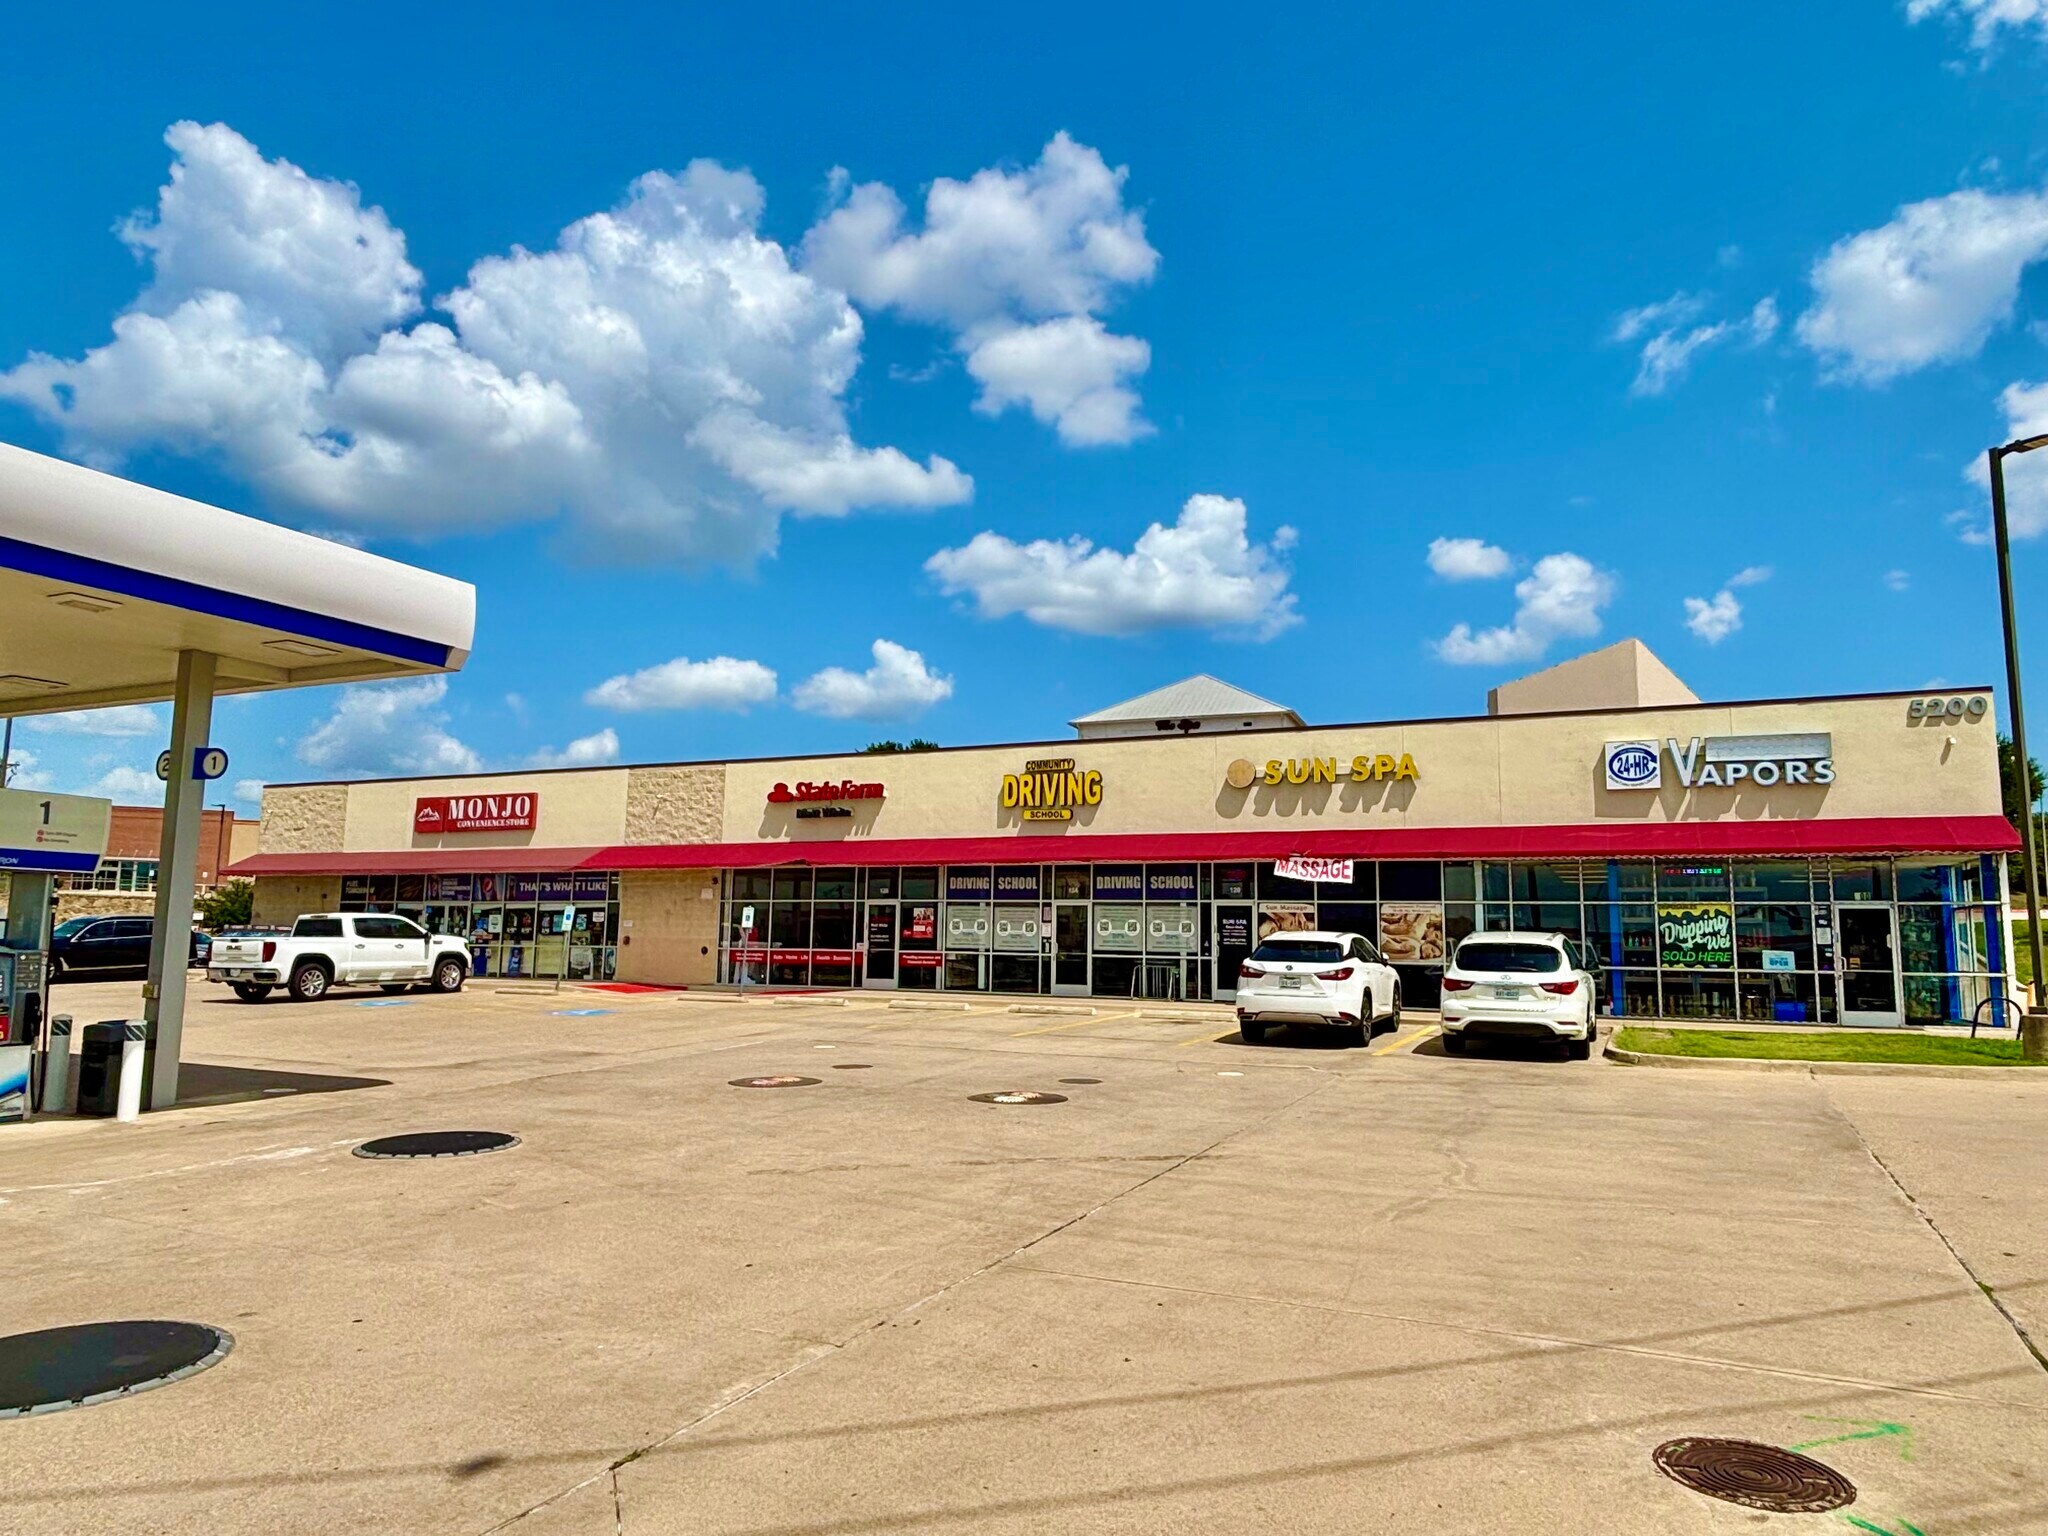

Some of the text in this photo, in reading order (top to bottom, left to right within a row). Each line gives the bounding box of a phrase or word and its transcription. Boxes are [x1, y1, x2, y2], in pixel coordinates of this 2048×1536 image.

[1910, 696, 1988, 718] 5200
[162, 757, 170, 771] 2
[211, 756, 217, 770] 1
[1026, 759, 1072, 770] COMMUNITY
[1264, 753, 1421, 785] SUN SPA
[1617, 754, 1650, 776] 24-HR
[1667, 737, 1836, 787] VAPORS
[1003, 770, 1103, 807] DRIVING
[40, 801, 51, 825] 1
[448, 796, 531, 820] MONJO
[1030, 811, 1065, 819] SCHOOL
[457, 818, 530, 828] CONVENIENCE STORE
[1276, 859, 1351, 879] MASSAGE
[520, 882, 551, 892] THAT'S
[553, 881, 581, 892] WHAT
[587, 881, 608, 891] LIKE
[950, 877, 1038, 890] DRIVING SCHOOL
[1096, 876, 1195, 889] DRIVING SCHOOL
[1660, 914, 1729, 948] Dripping
[1705, 934, 1731, 950] Wet
[1662, 951, 1732, 962] SOLD HERE
